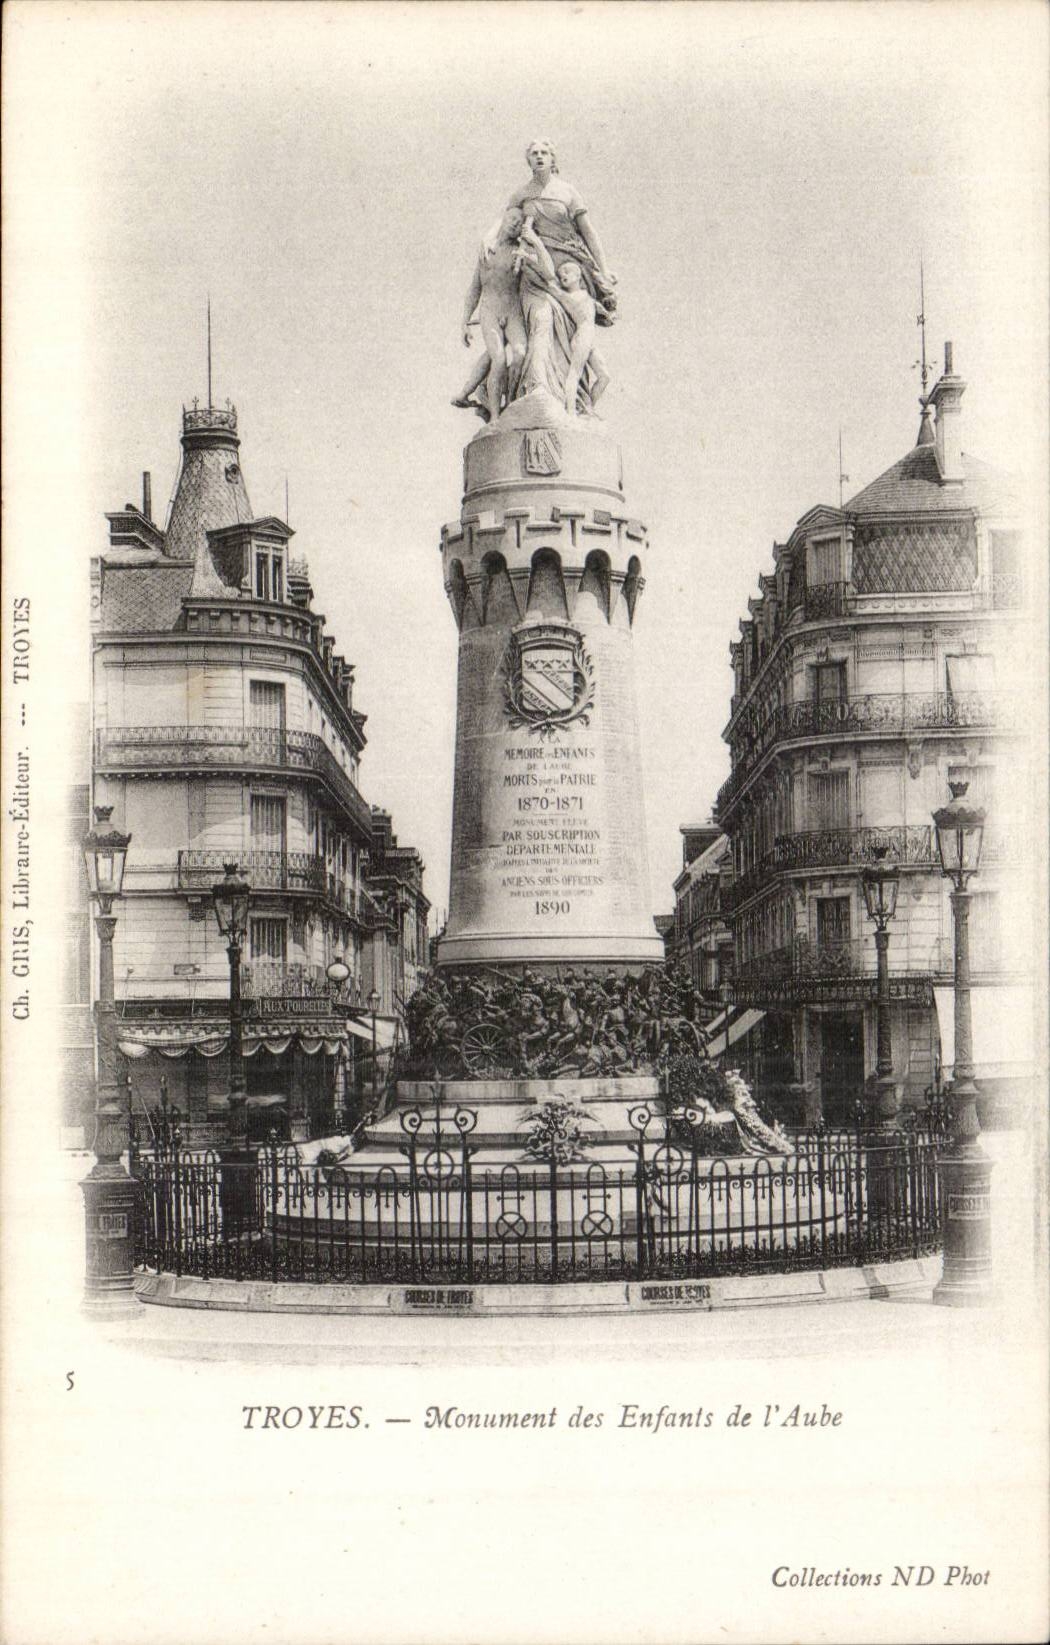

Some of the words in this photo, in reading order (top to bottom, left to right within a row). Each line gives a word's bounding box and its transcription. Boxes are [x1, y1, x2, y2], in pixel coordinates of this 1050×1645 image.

[503, 773, 538, 787] MORTS
[560, 773, 597, 786] PATRIE
[518, 796, 583, 811] 1870-1871
[502, 830, 522, 842] PAR
[526, 829, 600, 841] SOUSCRIPTION
[502, 875, 536, 887] ANCIENS
[535, 900, 571, 915] 1890
